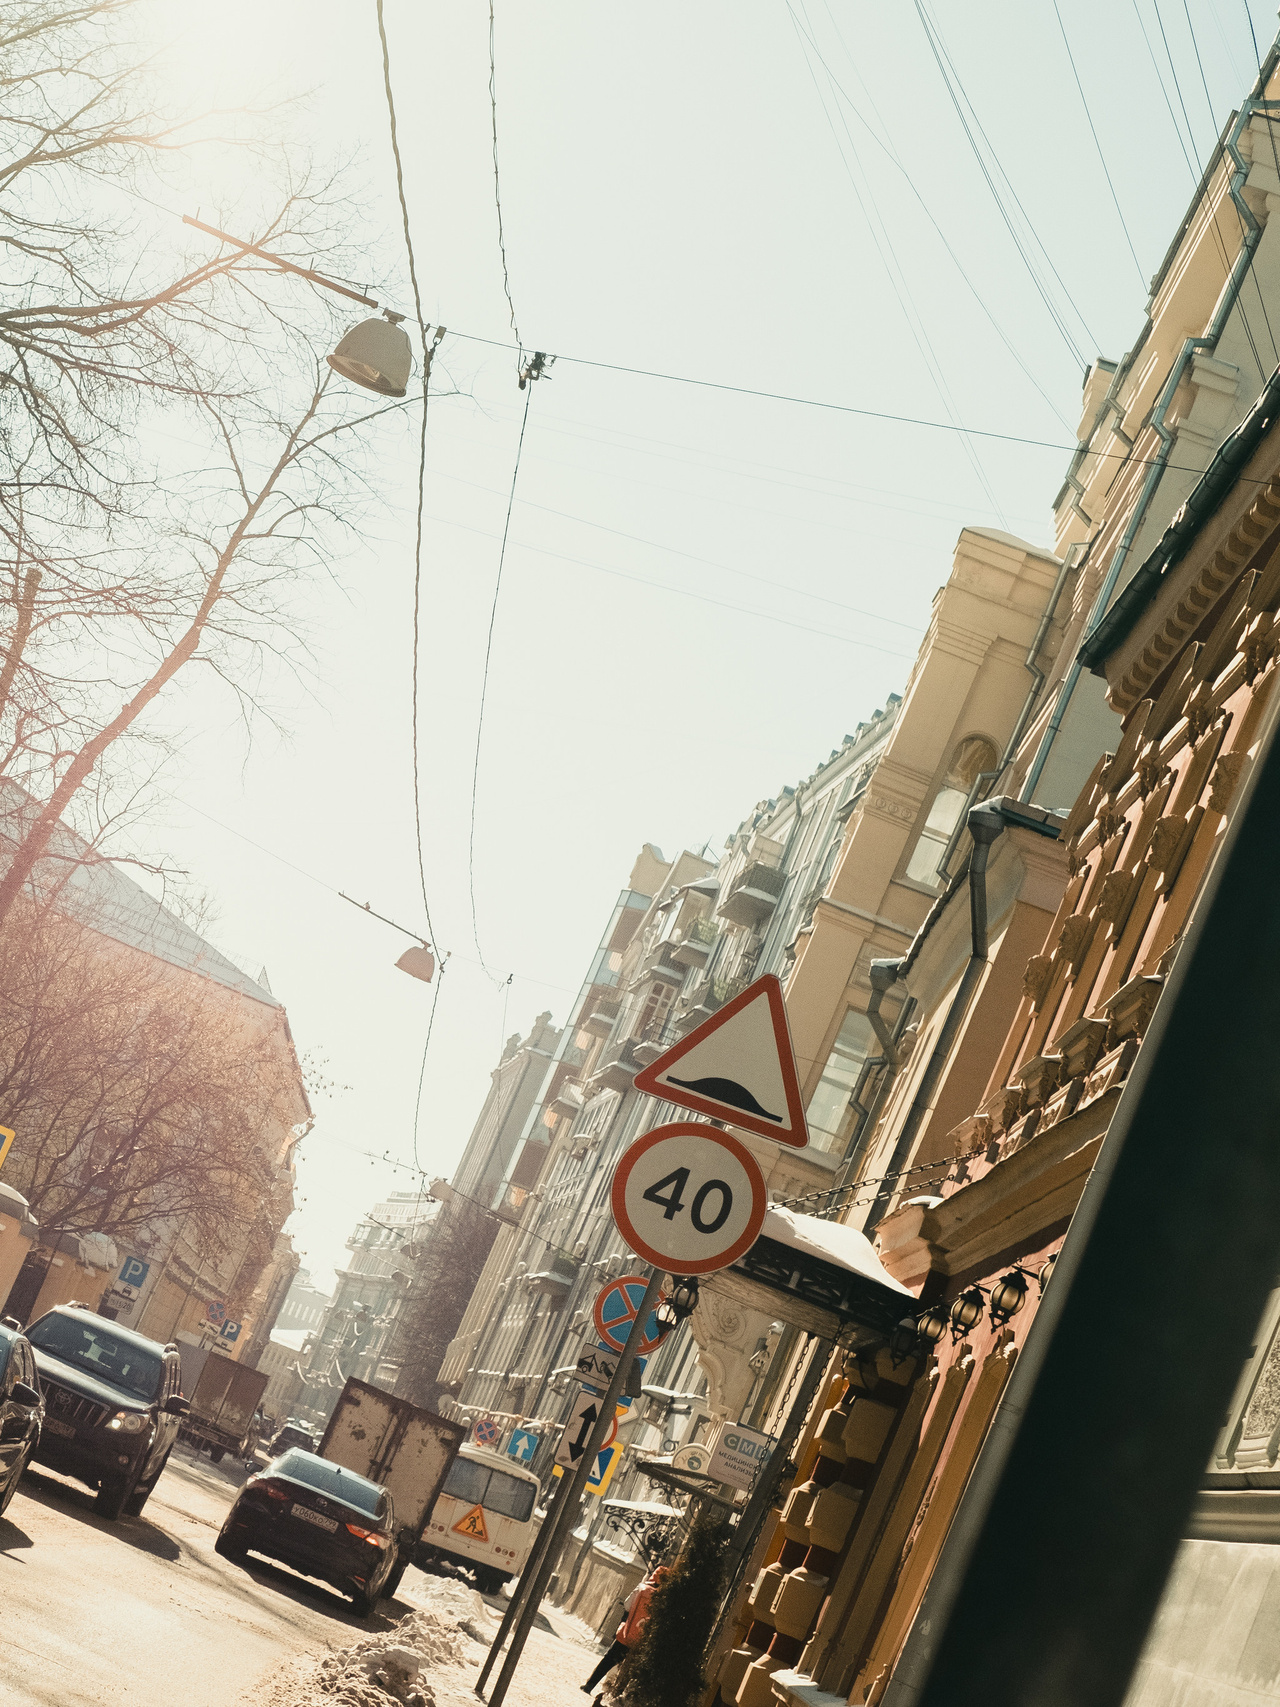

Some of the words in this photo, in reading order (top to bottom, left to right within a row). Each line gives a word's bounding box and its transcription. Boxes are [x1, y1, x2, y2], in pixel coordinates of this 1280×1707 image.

[642, 1166, 733, 1234] 40
[124, 1260, 143, 1279] P
[224, 1321, 237, 1336] P
